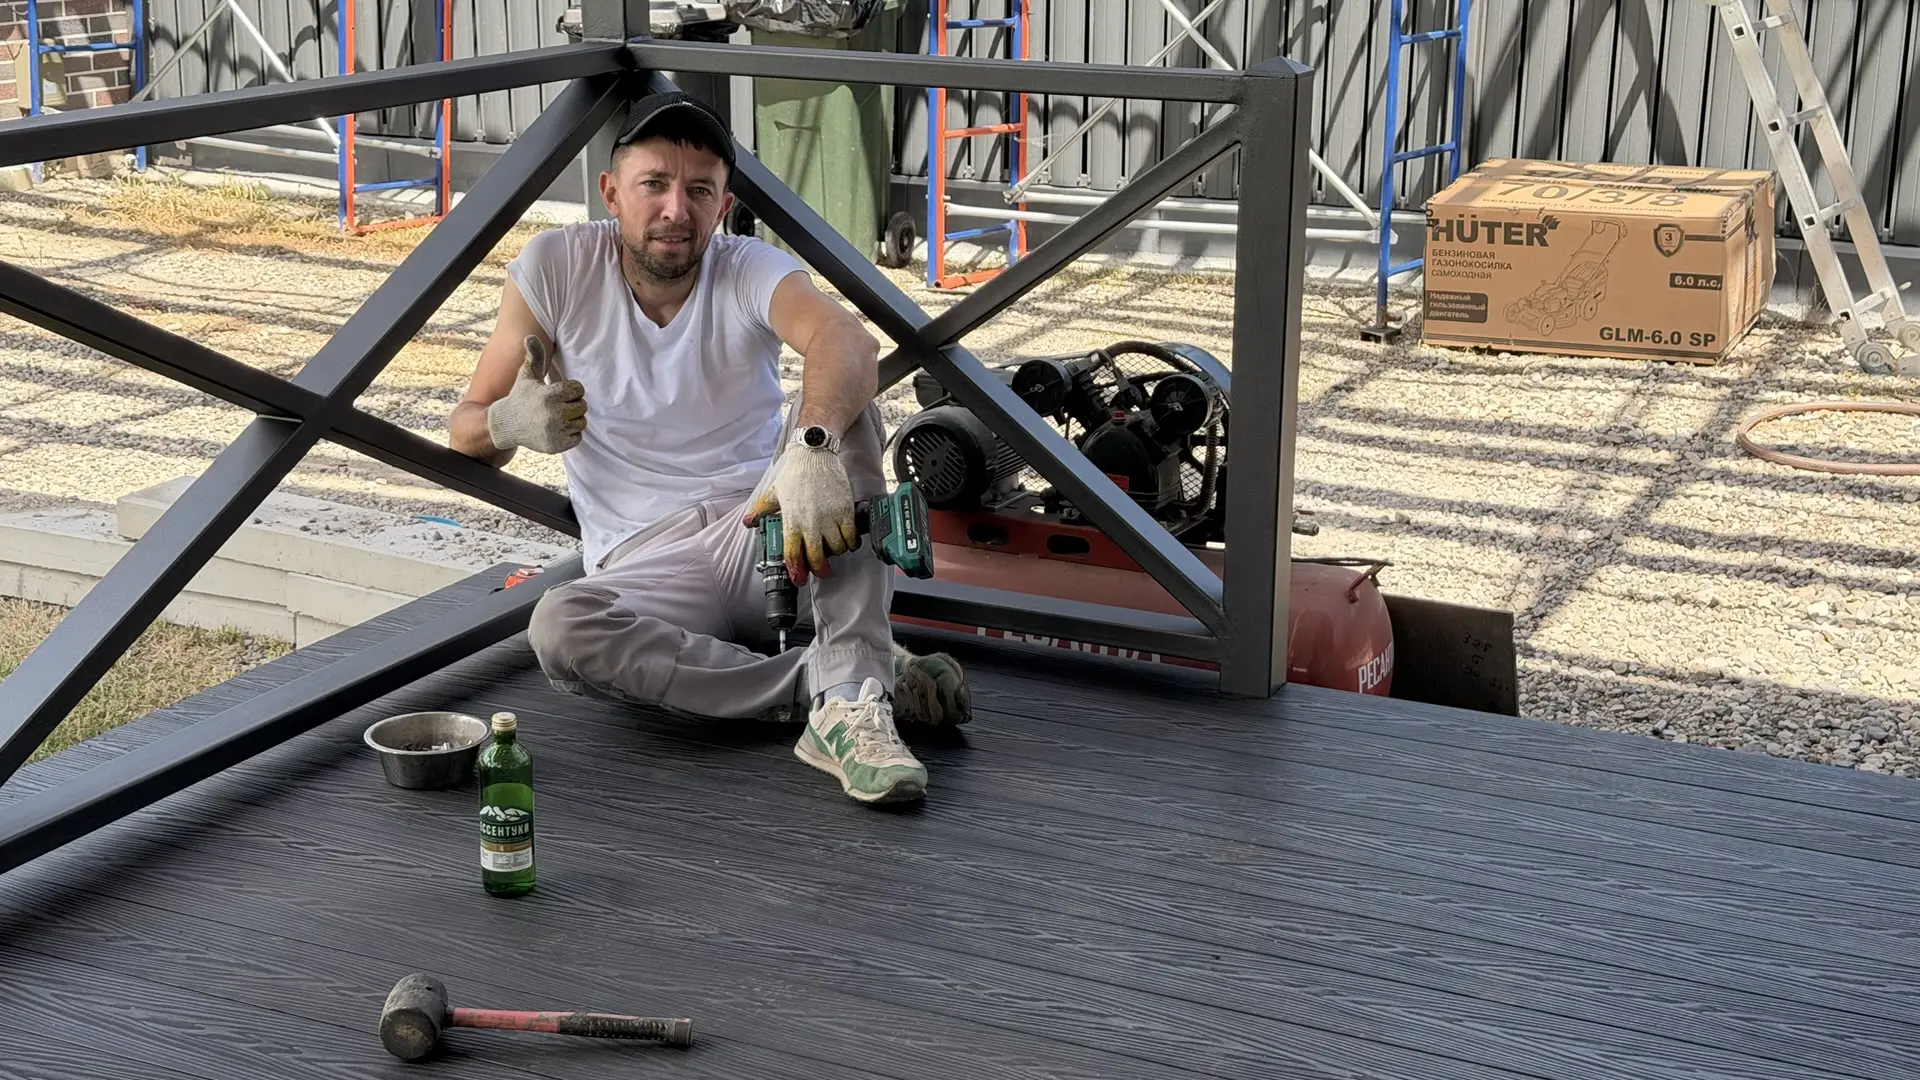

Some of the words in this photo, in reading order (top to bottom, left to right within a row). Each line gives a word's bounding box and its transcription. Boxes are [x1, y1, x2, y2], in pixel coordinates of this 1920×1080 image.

[1432, 214, 1549, 247] HÜTER
[1432, 249, 1495, 259] БЕНЗИНОВАЯ
[1432, 259, 1512, 270] ГАЗОНОКОСИЛКА
[1431, 270, 1492, 279] самоходная
[1675, 275, 1694, 286] 6.0
[1599, 326, 1682, 345] GLM-6.0
[1689, 332, 1716, 347] SP
